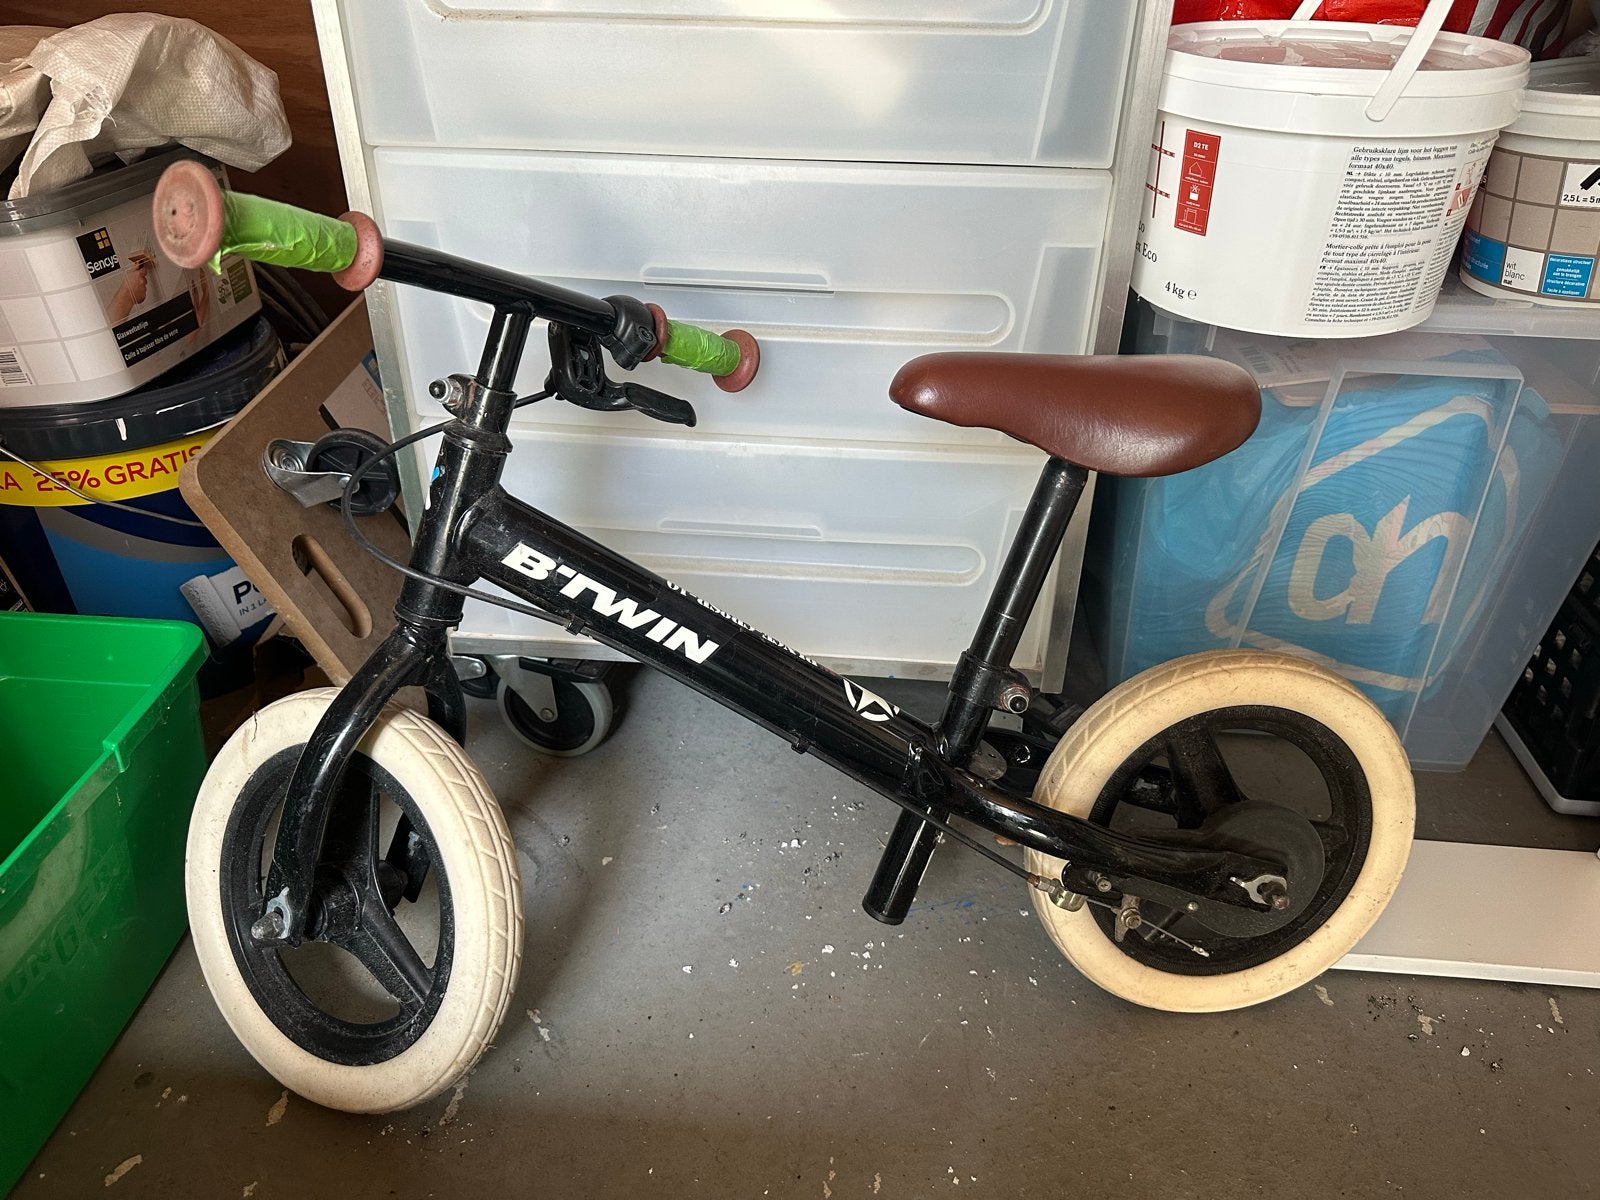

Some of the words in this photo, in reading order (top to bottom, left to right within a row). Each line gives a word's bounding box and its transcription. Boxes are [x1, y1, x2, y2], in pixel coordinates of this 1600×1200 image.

[1142, 242, 1157, 263] Eco
[86, 253, 120, 274] Sencys
[1505, 269, 1525, 280] blanc
[1165, 281, 1171, 292] 4
[1172, 283, 1185, 299] kg
[124, 350, 136, 361] Colle
[32, 468, 101, 492] 25%
[233, 580, 260, 605] P
[239, 606, 249, 616] IN
